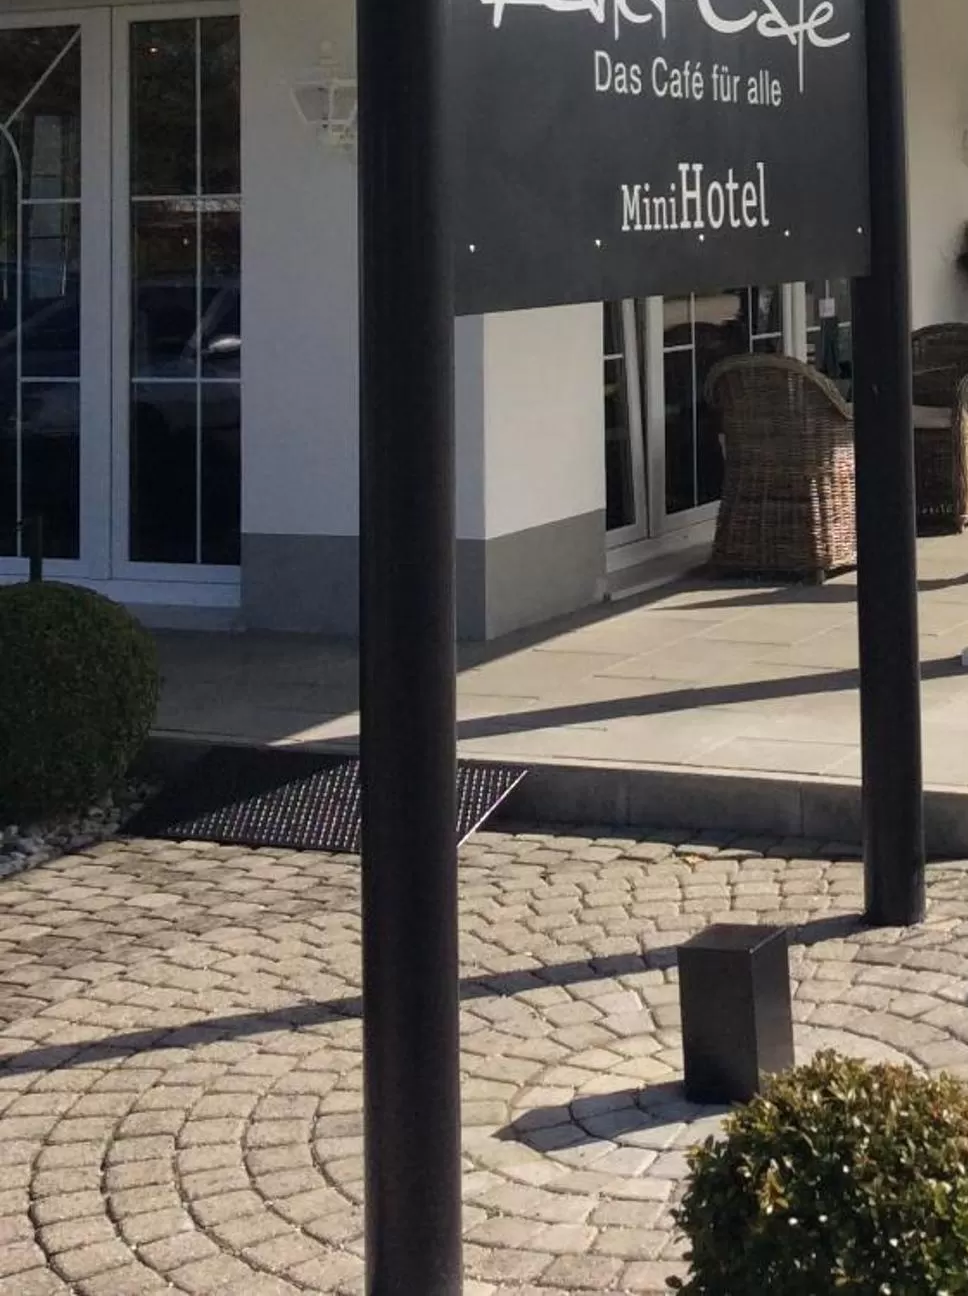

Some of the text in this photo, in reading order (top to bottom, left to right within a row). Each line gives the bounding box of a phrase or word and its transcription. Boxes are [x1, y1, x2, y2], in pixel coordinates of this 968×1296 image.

[594, 50, 782, 106] Das Café für alle
[621, 162, 770, 231] MiniHotel
